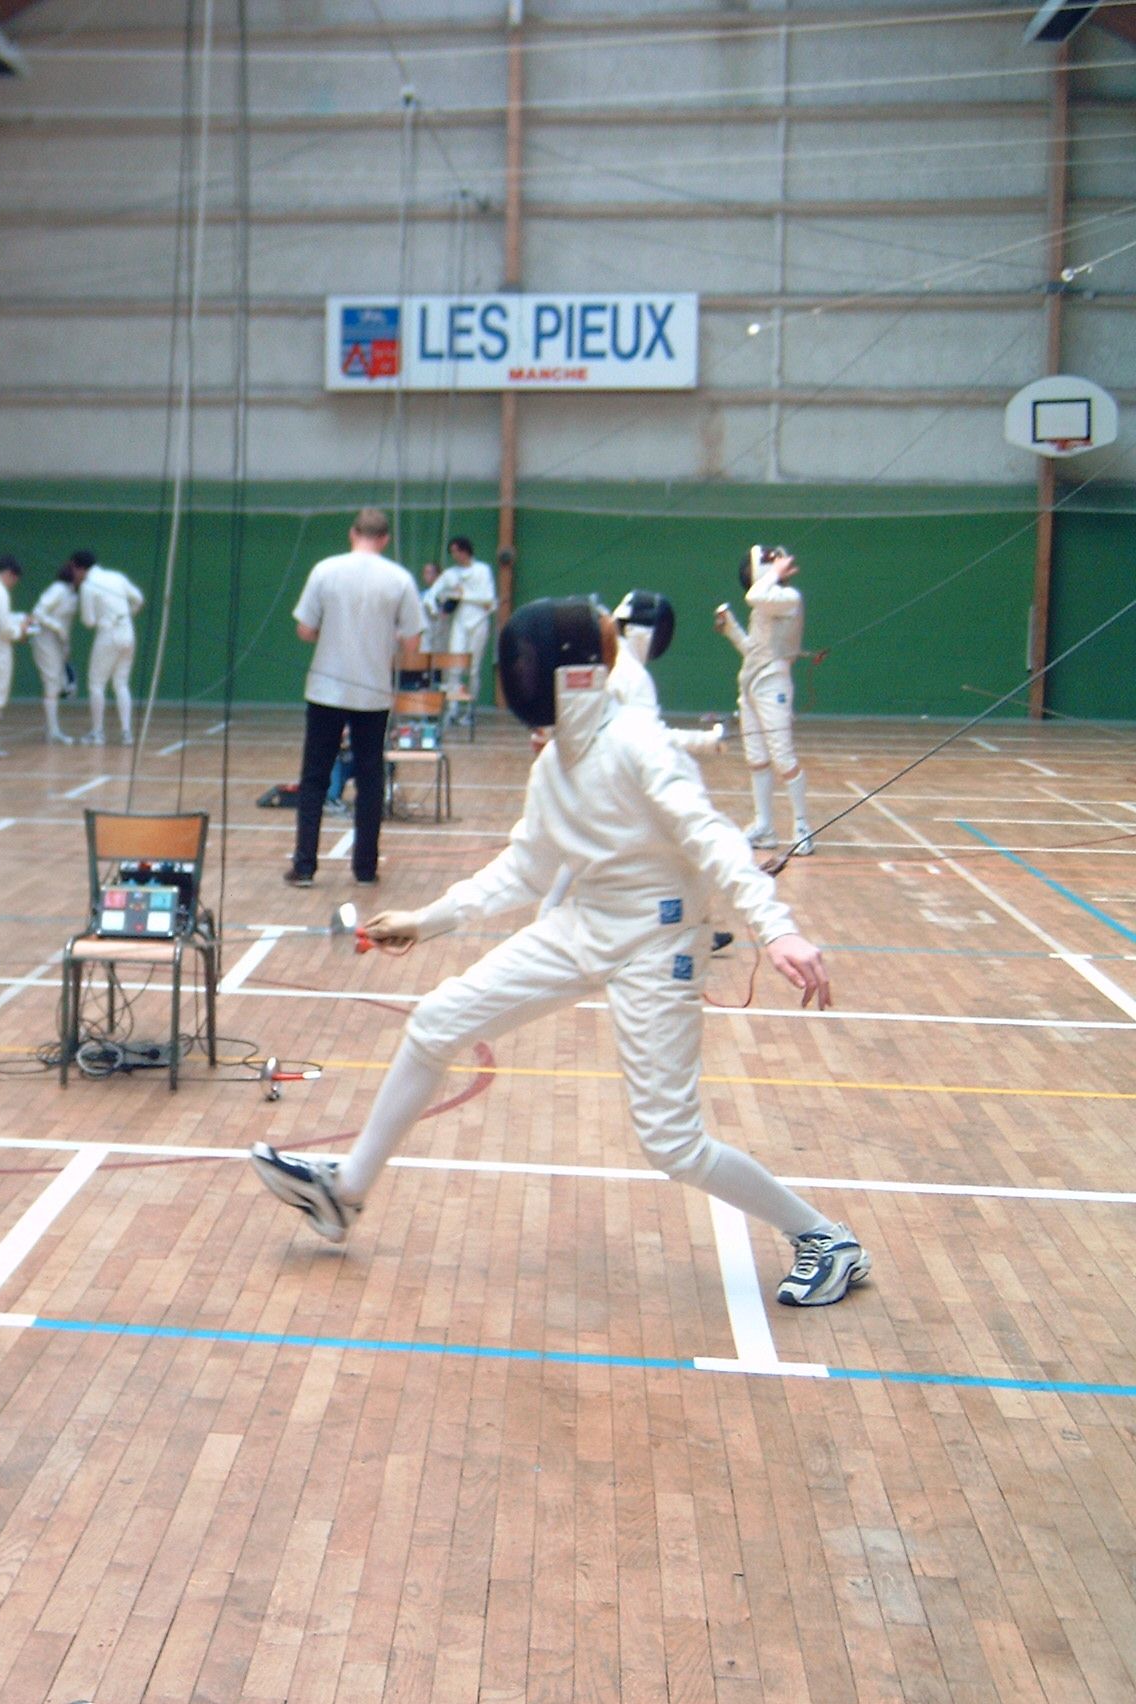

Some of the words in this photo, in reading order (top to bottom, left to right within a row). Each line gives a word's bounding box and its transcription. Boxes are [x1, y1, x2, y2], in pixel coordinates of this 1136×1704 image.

[419, 303, 510, 362] LES
[532, 303, 676, 361] PIEUX
[508, 367, 588, 381] MANCHE
